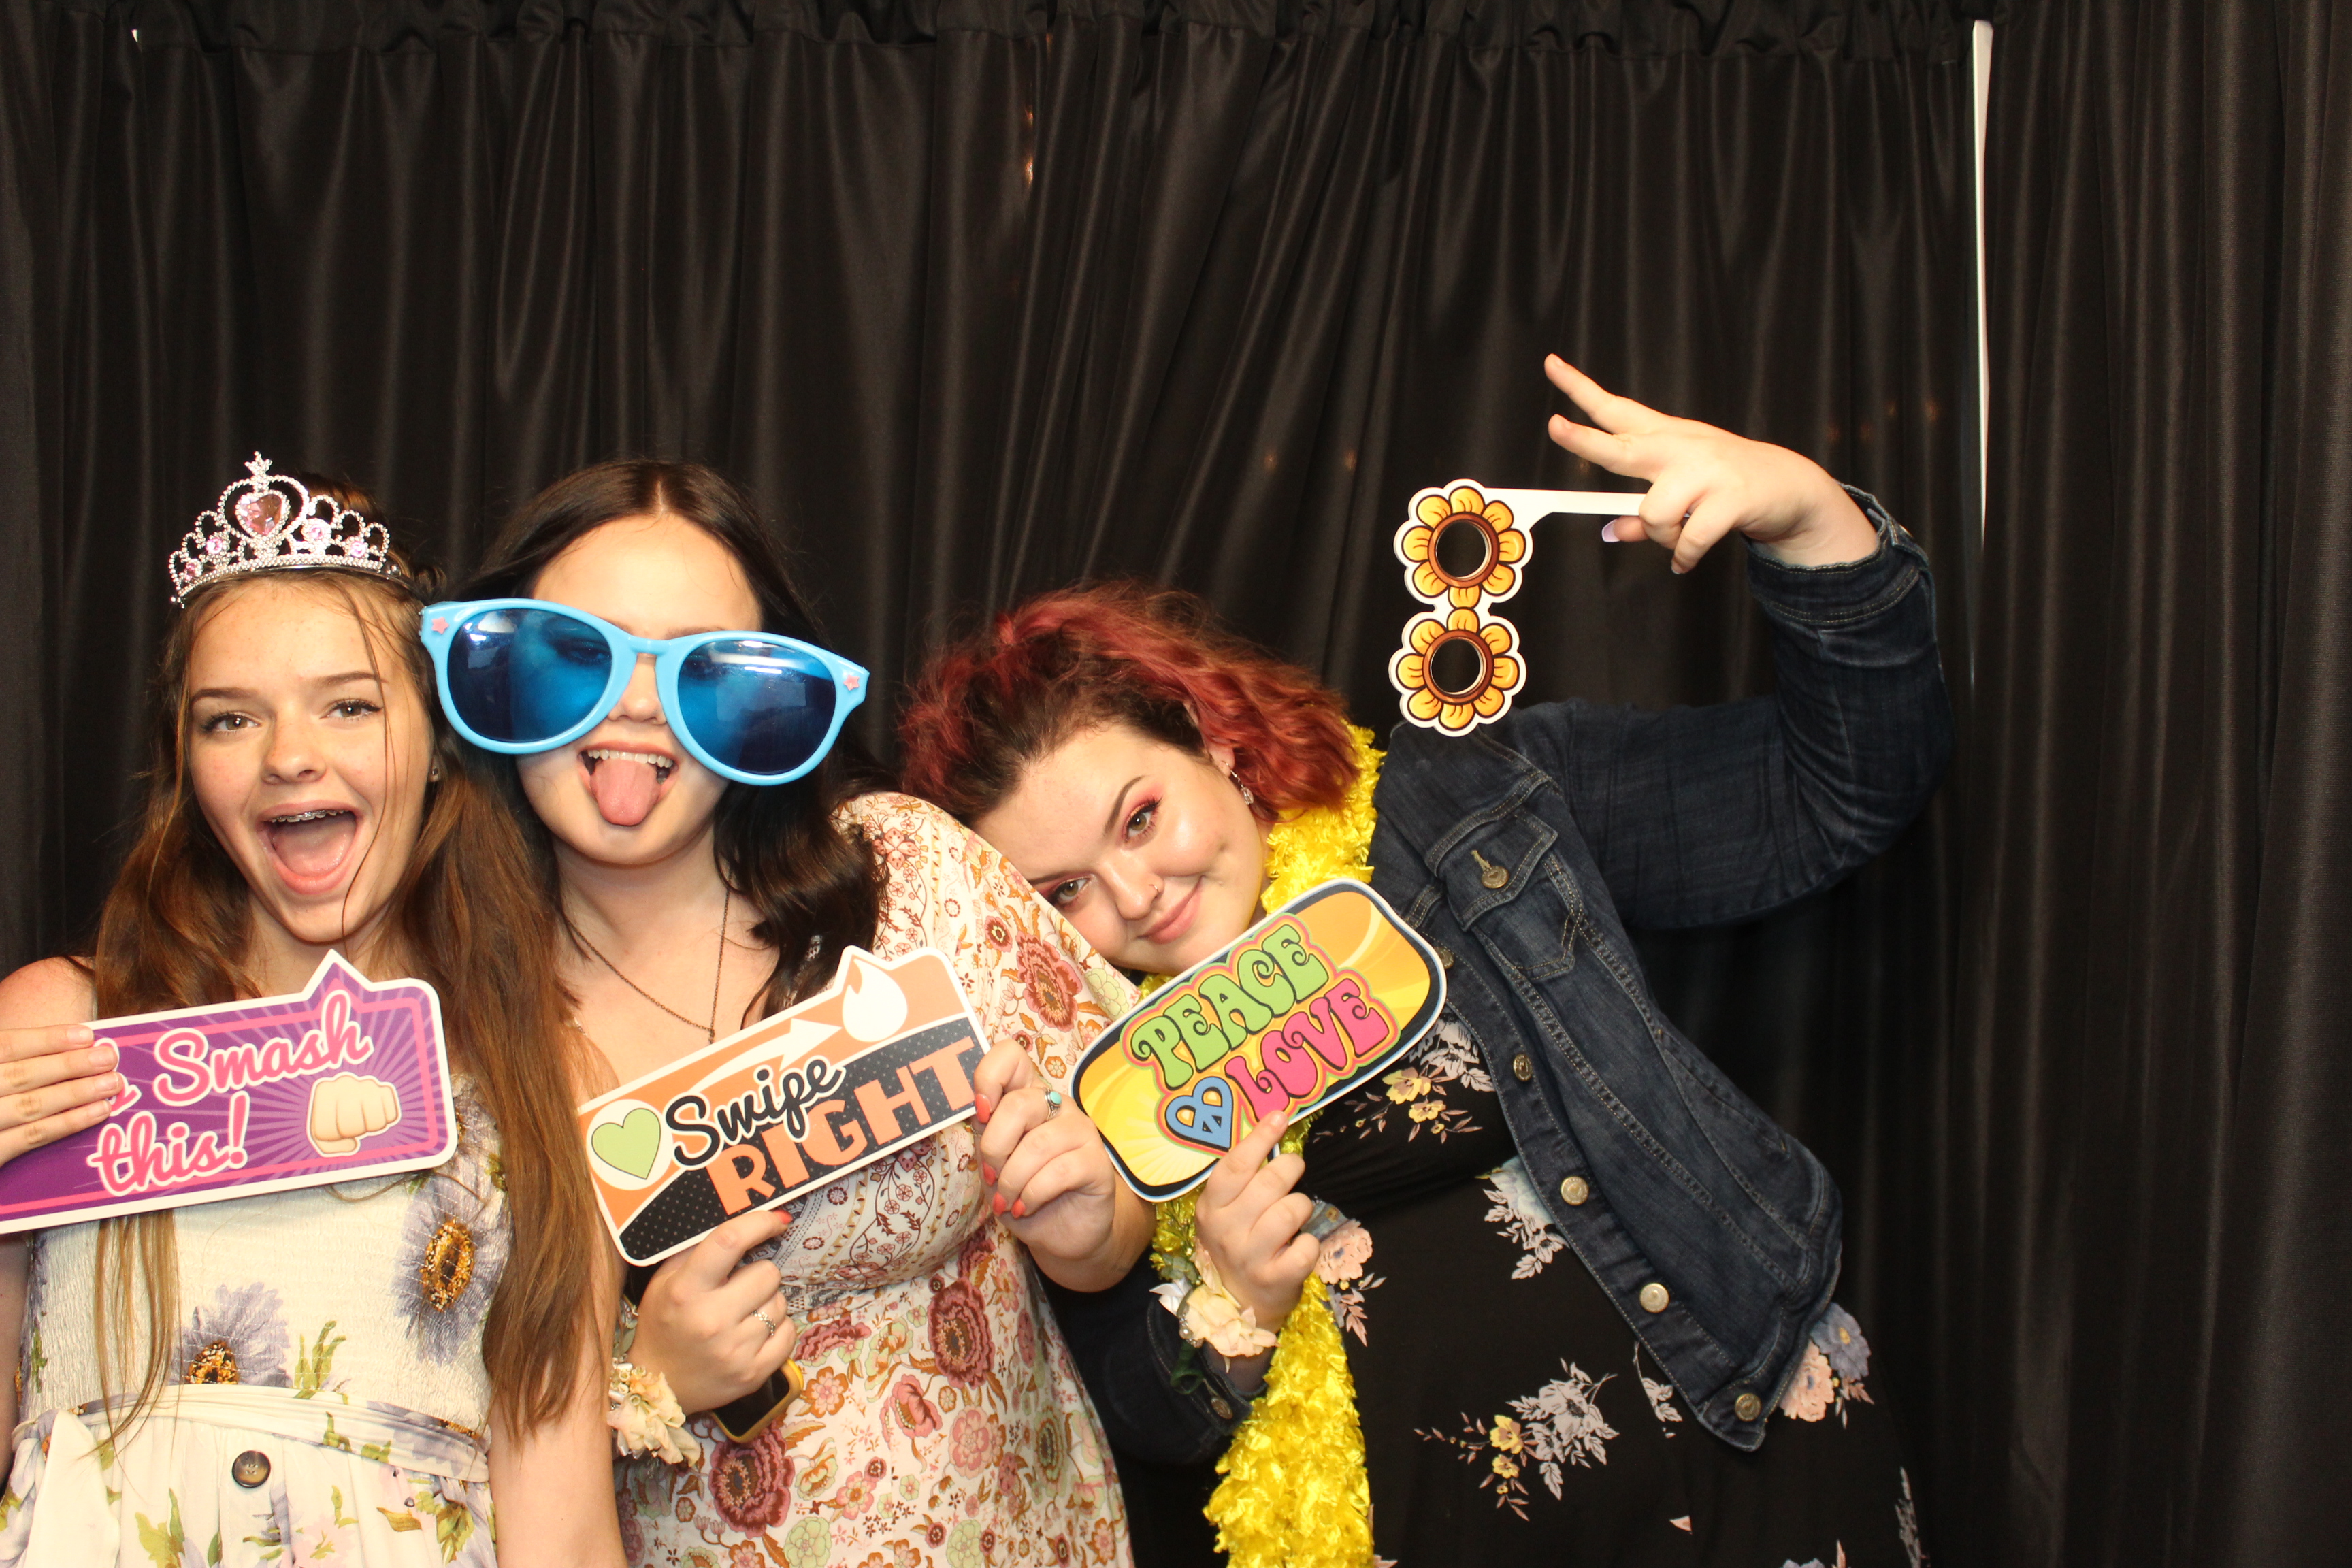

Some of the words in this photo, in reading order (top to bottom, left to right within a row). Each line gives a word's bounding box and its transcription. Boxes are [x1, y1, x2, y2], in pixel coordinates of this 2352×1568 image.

[154, 990, 374, 1106] Smash
[1131, 924, 1330, 1090] PEACE
[1224, 978, 1390, 1124] LOVE
[87, 1090, 250, 1196] this!
[665, 1058, 844, 1166] Swipe
[706, 1036, 975, 1215] RIGHT
